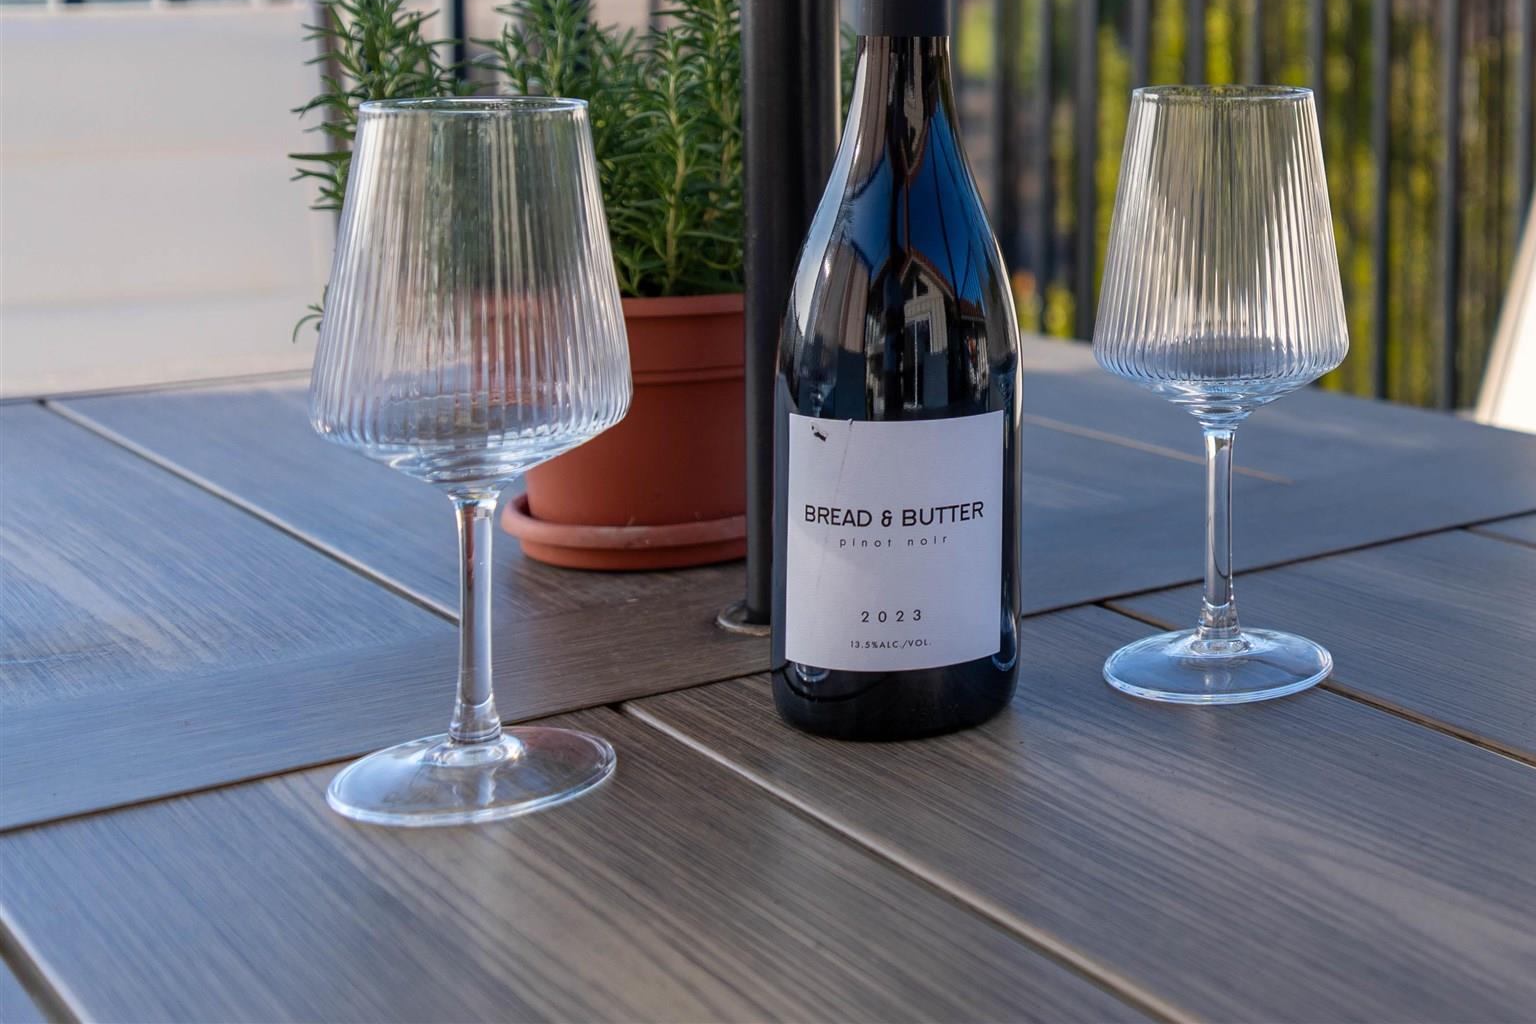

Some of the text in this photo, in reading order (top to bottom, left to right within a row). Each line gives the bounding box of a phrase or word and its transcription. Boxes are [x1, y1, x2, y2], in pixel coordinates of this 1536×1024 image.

[804, 500, 985, 528] BREAD & BUTTER
[839, 534, 949, 549] pinot noir
[860, 609, 922, 623] 2023
